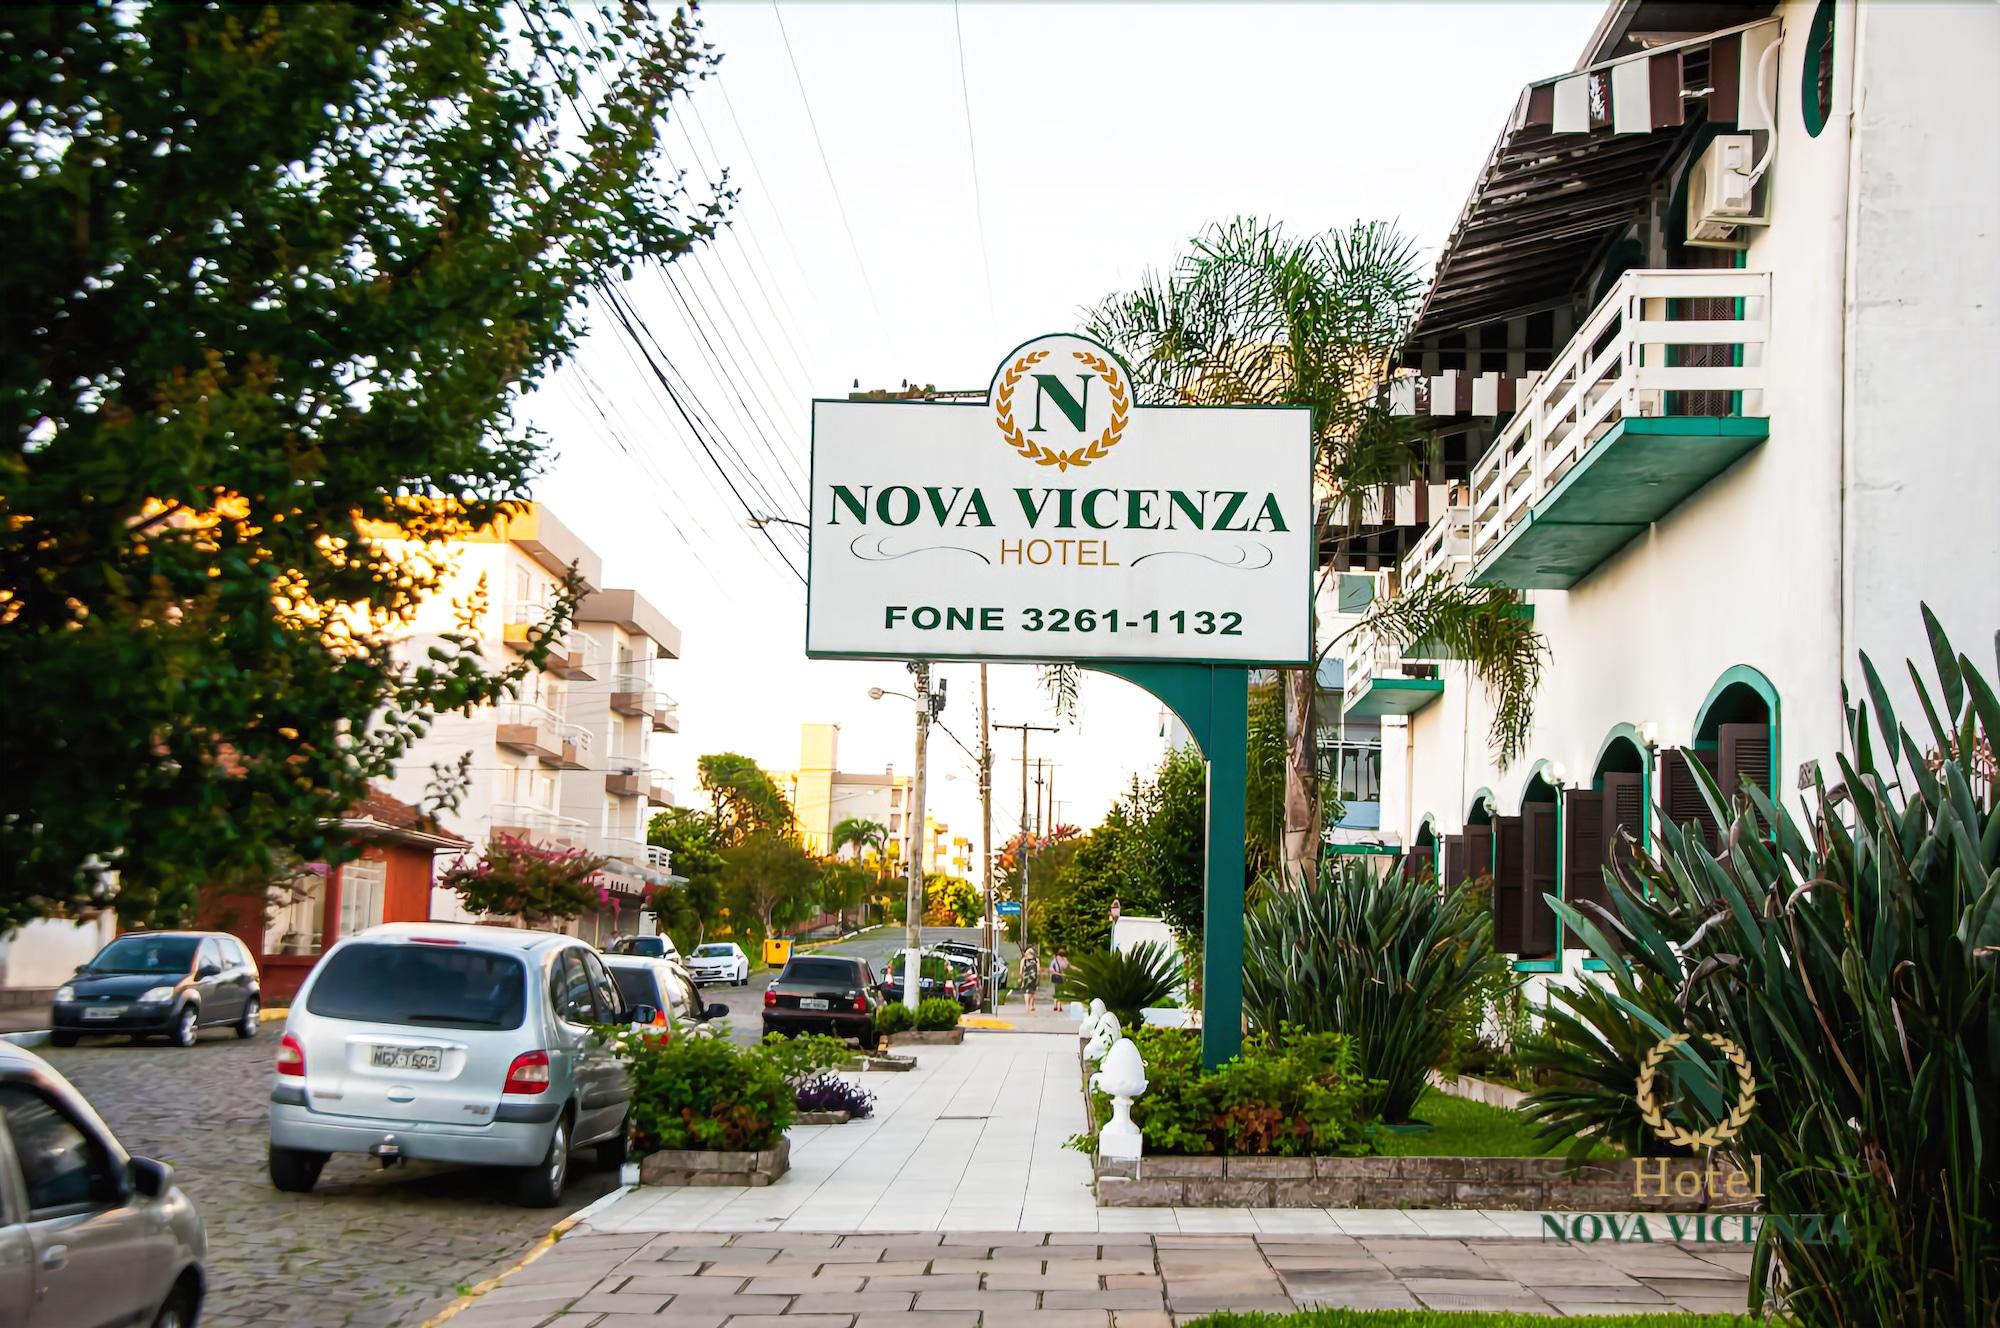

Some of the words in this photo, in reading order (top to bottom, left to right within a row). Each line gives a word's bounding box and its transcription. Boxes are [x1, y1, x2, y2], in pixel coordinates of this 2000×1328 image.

[1028, 374, 1095, 433] N
[827, 485, 996, 527] NOVA
[1014, 488, 1290, 533] VICENZA
[1000, 539, 1120, 567] HOTEL
[885, 606, 1005, 631] FONE
[1021, 608, 1243, 636] 3261-1132
